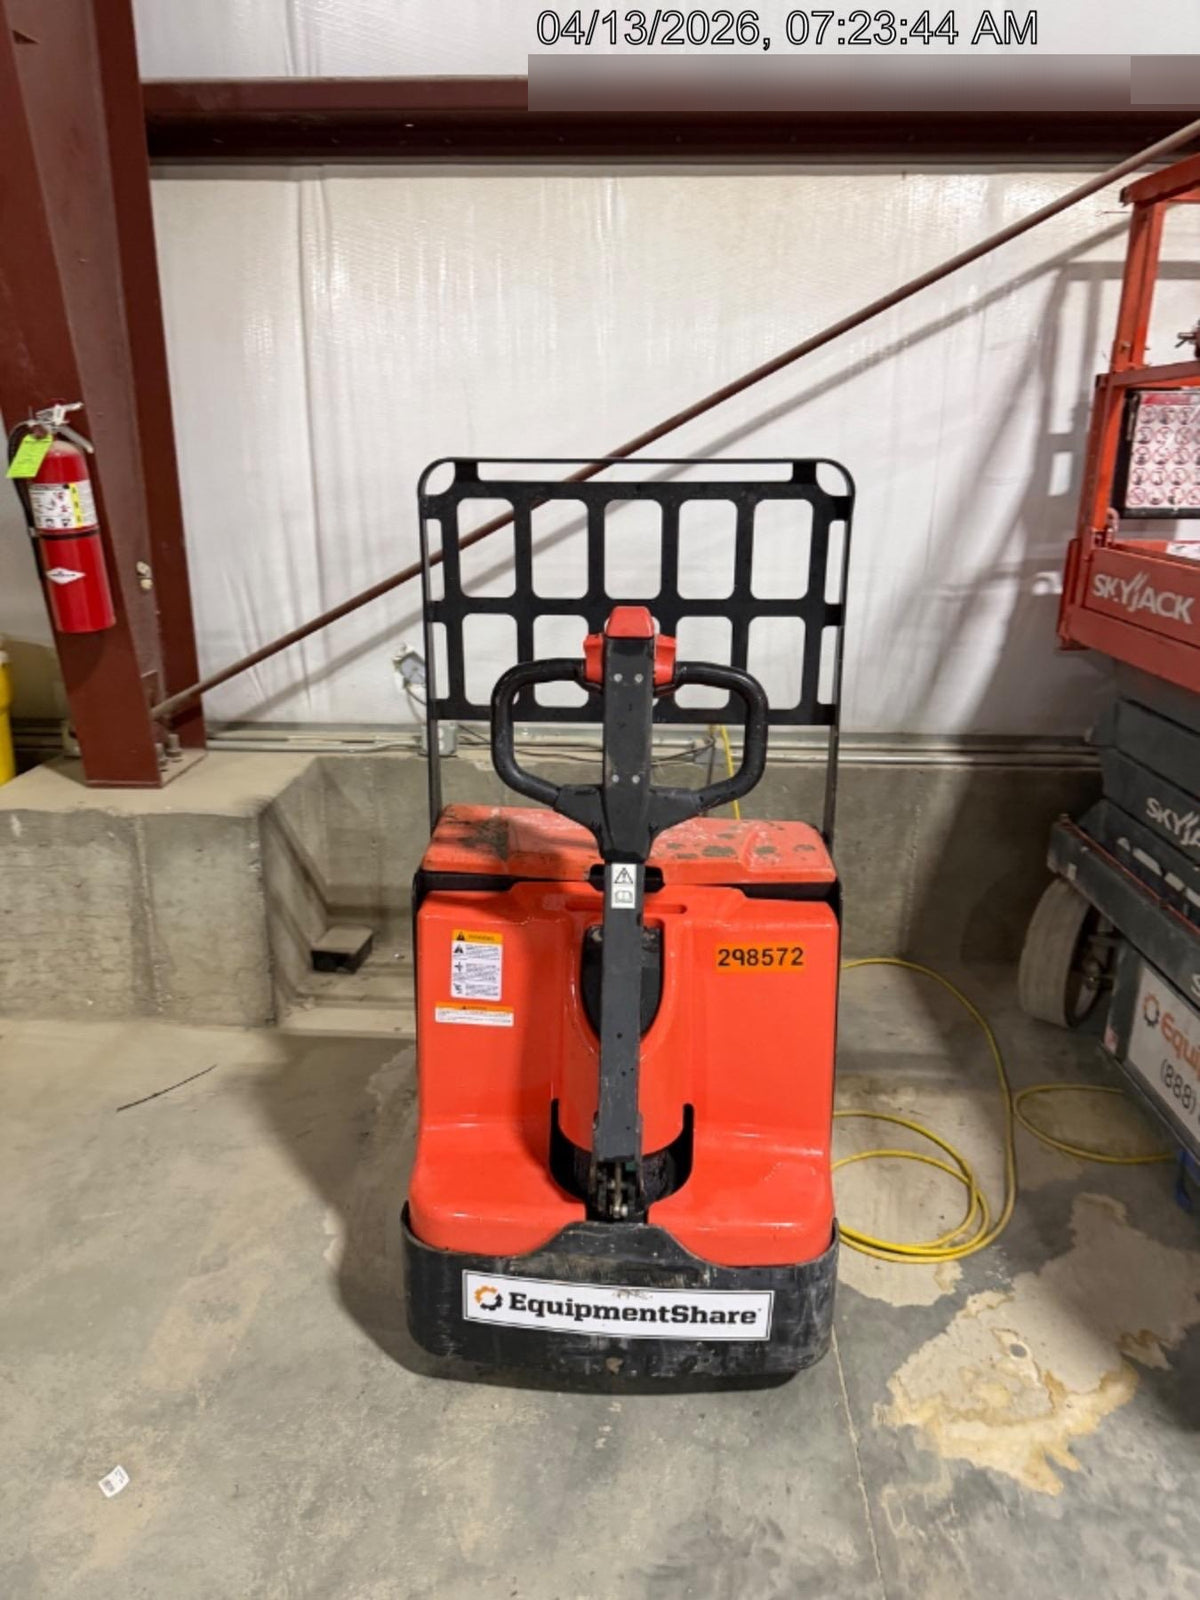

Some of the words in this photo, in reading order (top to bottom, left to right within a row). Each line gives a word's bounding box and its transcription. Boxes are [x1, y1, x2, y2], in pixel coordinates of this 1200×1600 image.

[1093, 571, 1194, 625] SKYJACK
[718, 947, 803, 966] 298572
[1160, 1059, 1196, 1115] (888)
[509, 1291, 756, 1326] EquipmentShare
